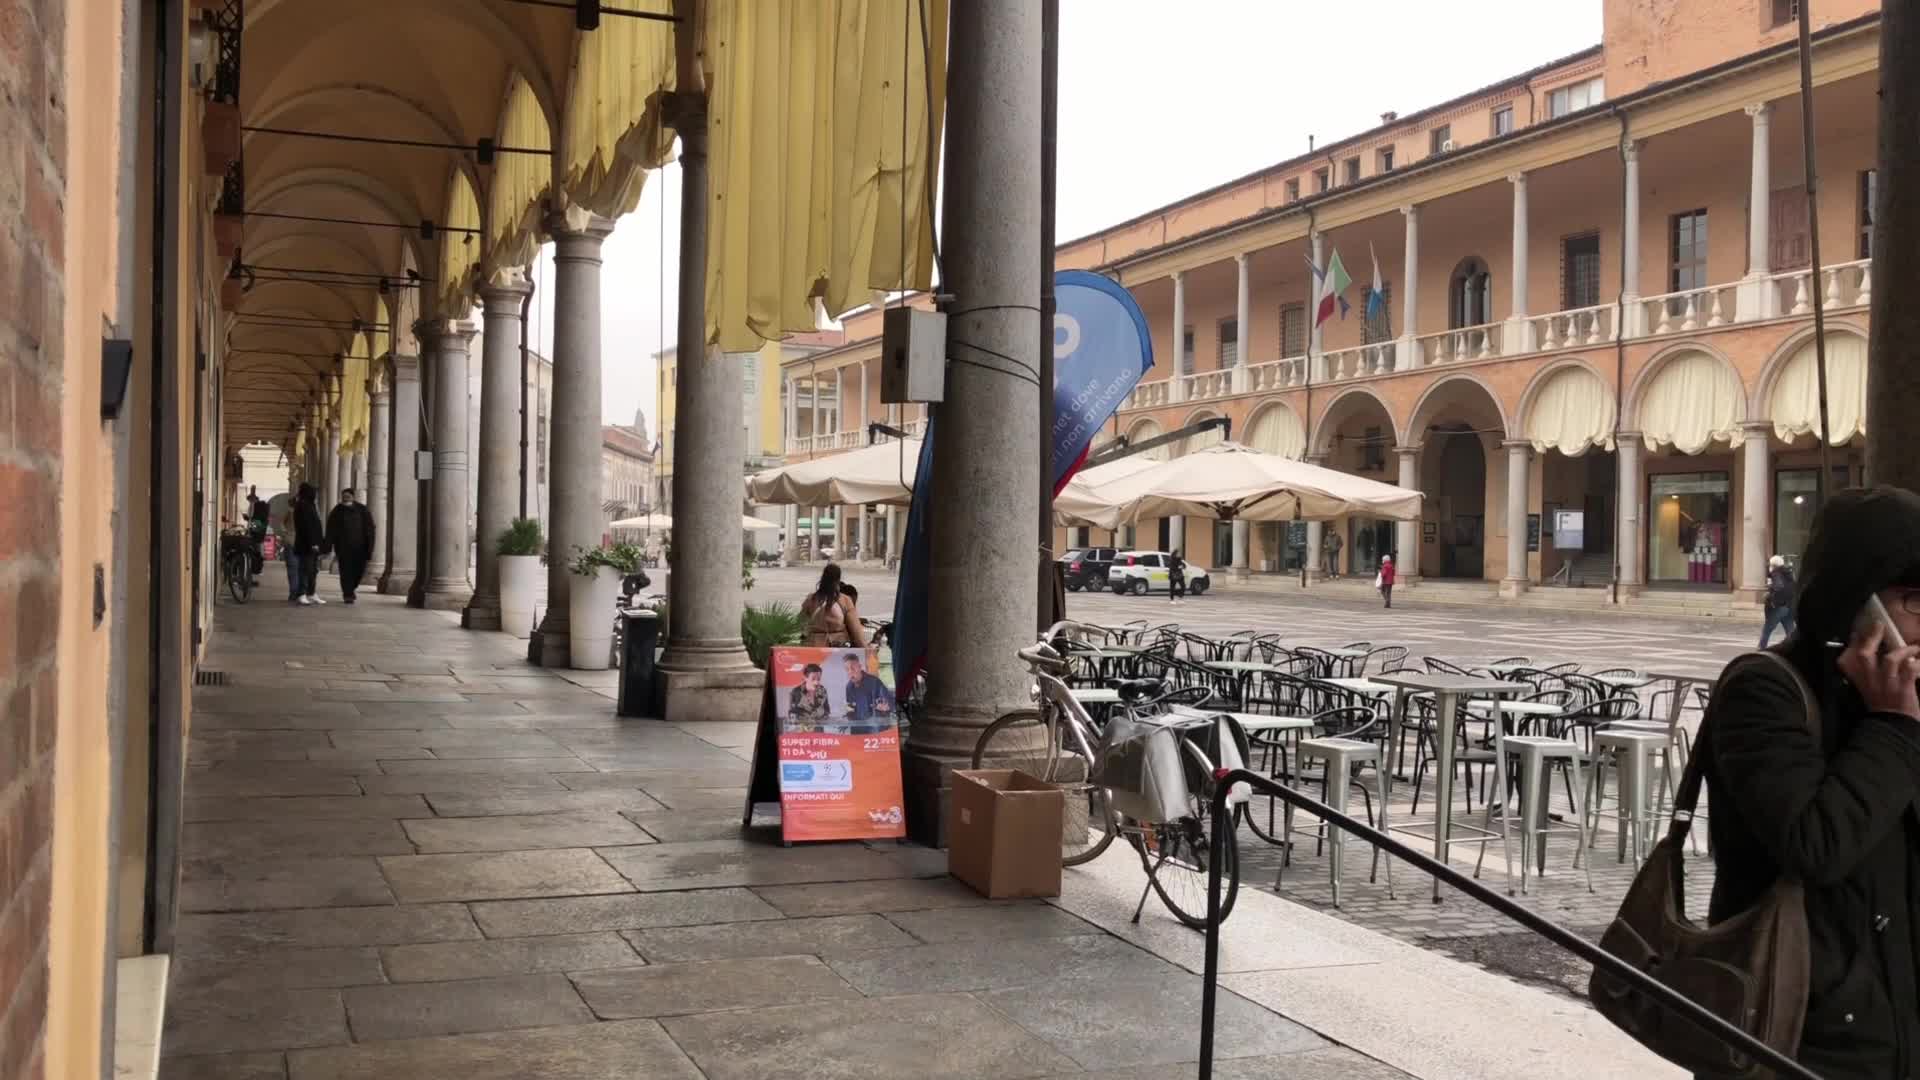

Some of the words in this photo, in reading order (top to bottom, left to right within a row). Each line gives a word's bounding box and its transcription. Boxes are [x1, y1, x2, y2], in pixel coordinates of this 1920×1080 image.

[1071, 379, 1098, 412] dove
[1061, 423, 1086, 450] non
[1084, 368, 1132, 423] arrivano
[781, 737, 811, 747] SUPER
[812, 737, 841, 747] FIBRA
[783, 792, 829, 801] INFORMATI
[830, 792, 845, 801] QUI
